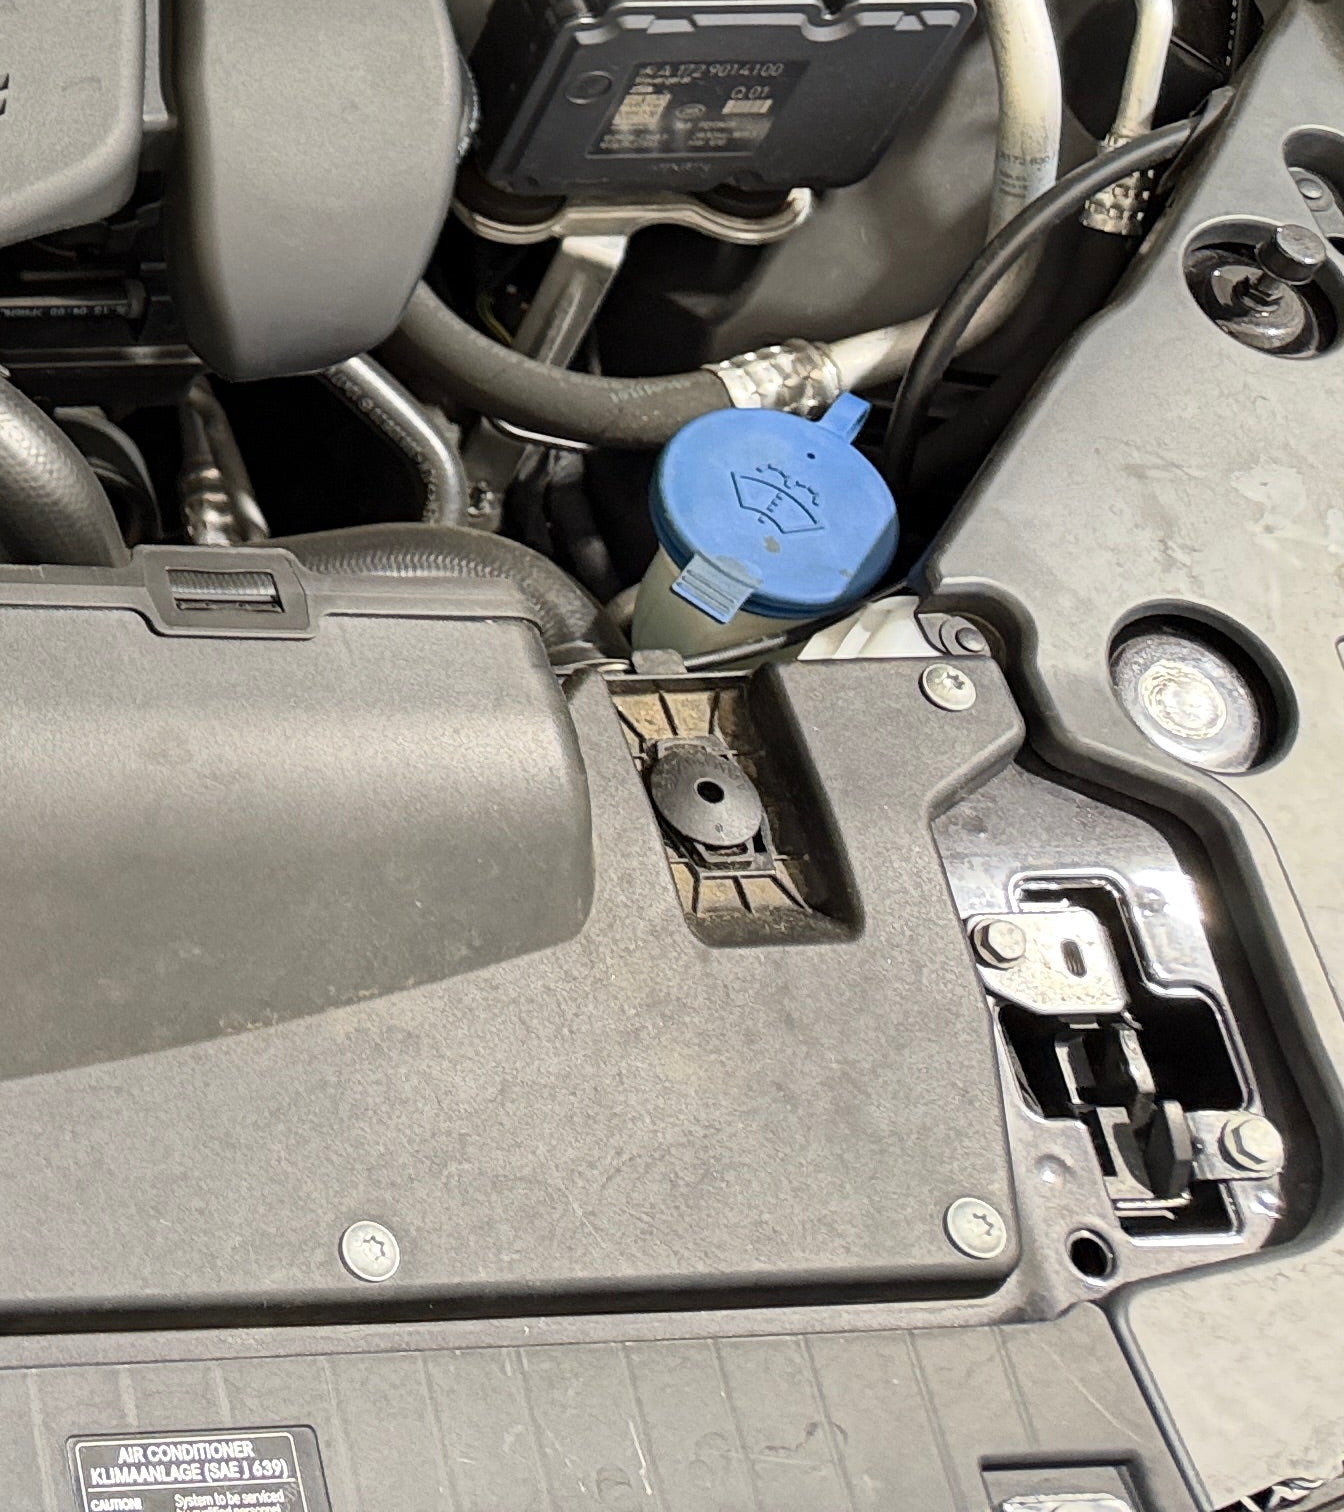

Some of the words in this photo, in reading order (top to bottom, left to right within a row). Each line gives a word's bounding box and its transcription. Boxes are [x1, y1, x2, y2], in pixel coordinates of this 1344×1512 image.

[118, 1445, 145, 1464] AIR
[145, 1440, 256, 1463] CONDITIONER
[90, 1464, 203, 1486] KLIMAANLAGE
[204, 1462, 241, 1483] (SAE
[242, 1462, 250, 1480] J
[252, 1458, 290, 1480] 639)
[173, 1493, 214, 1511] System
[214, 1491, 226, 1506] to
[226, 1490, 242, 1505] be
[242, 1488, 285, 1504] serviced
